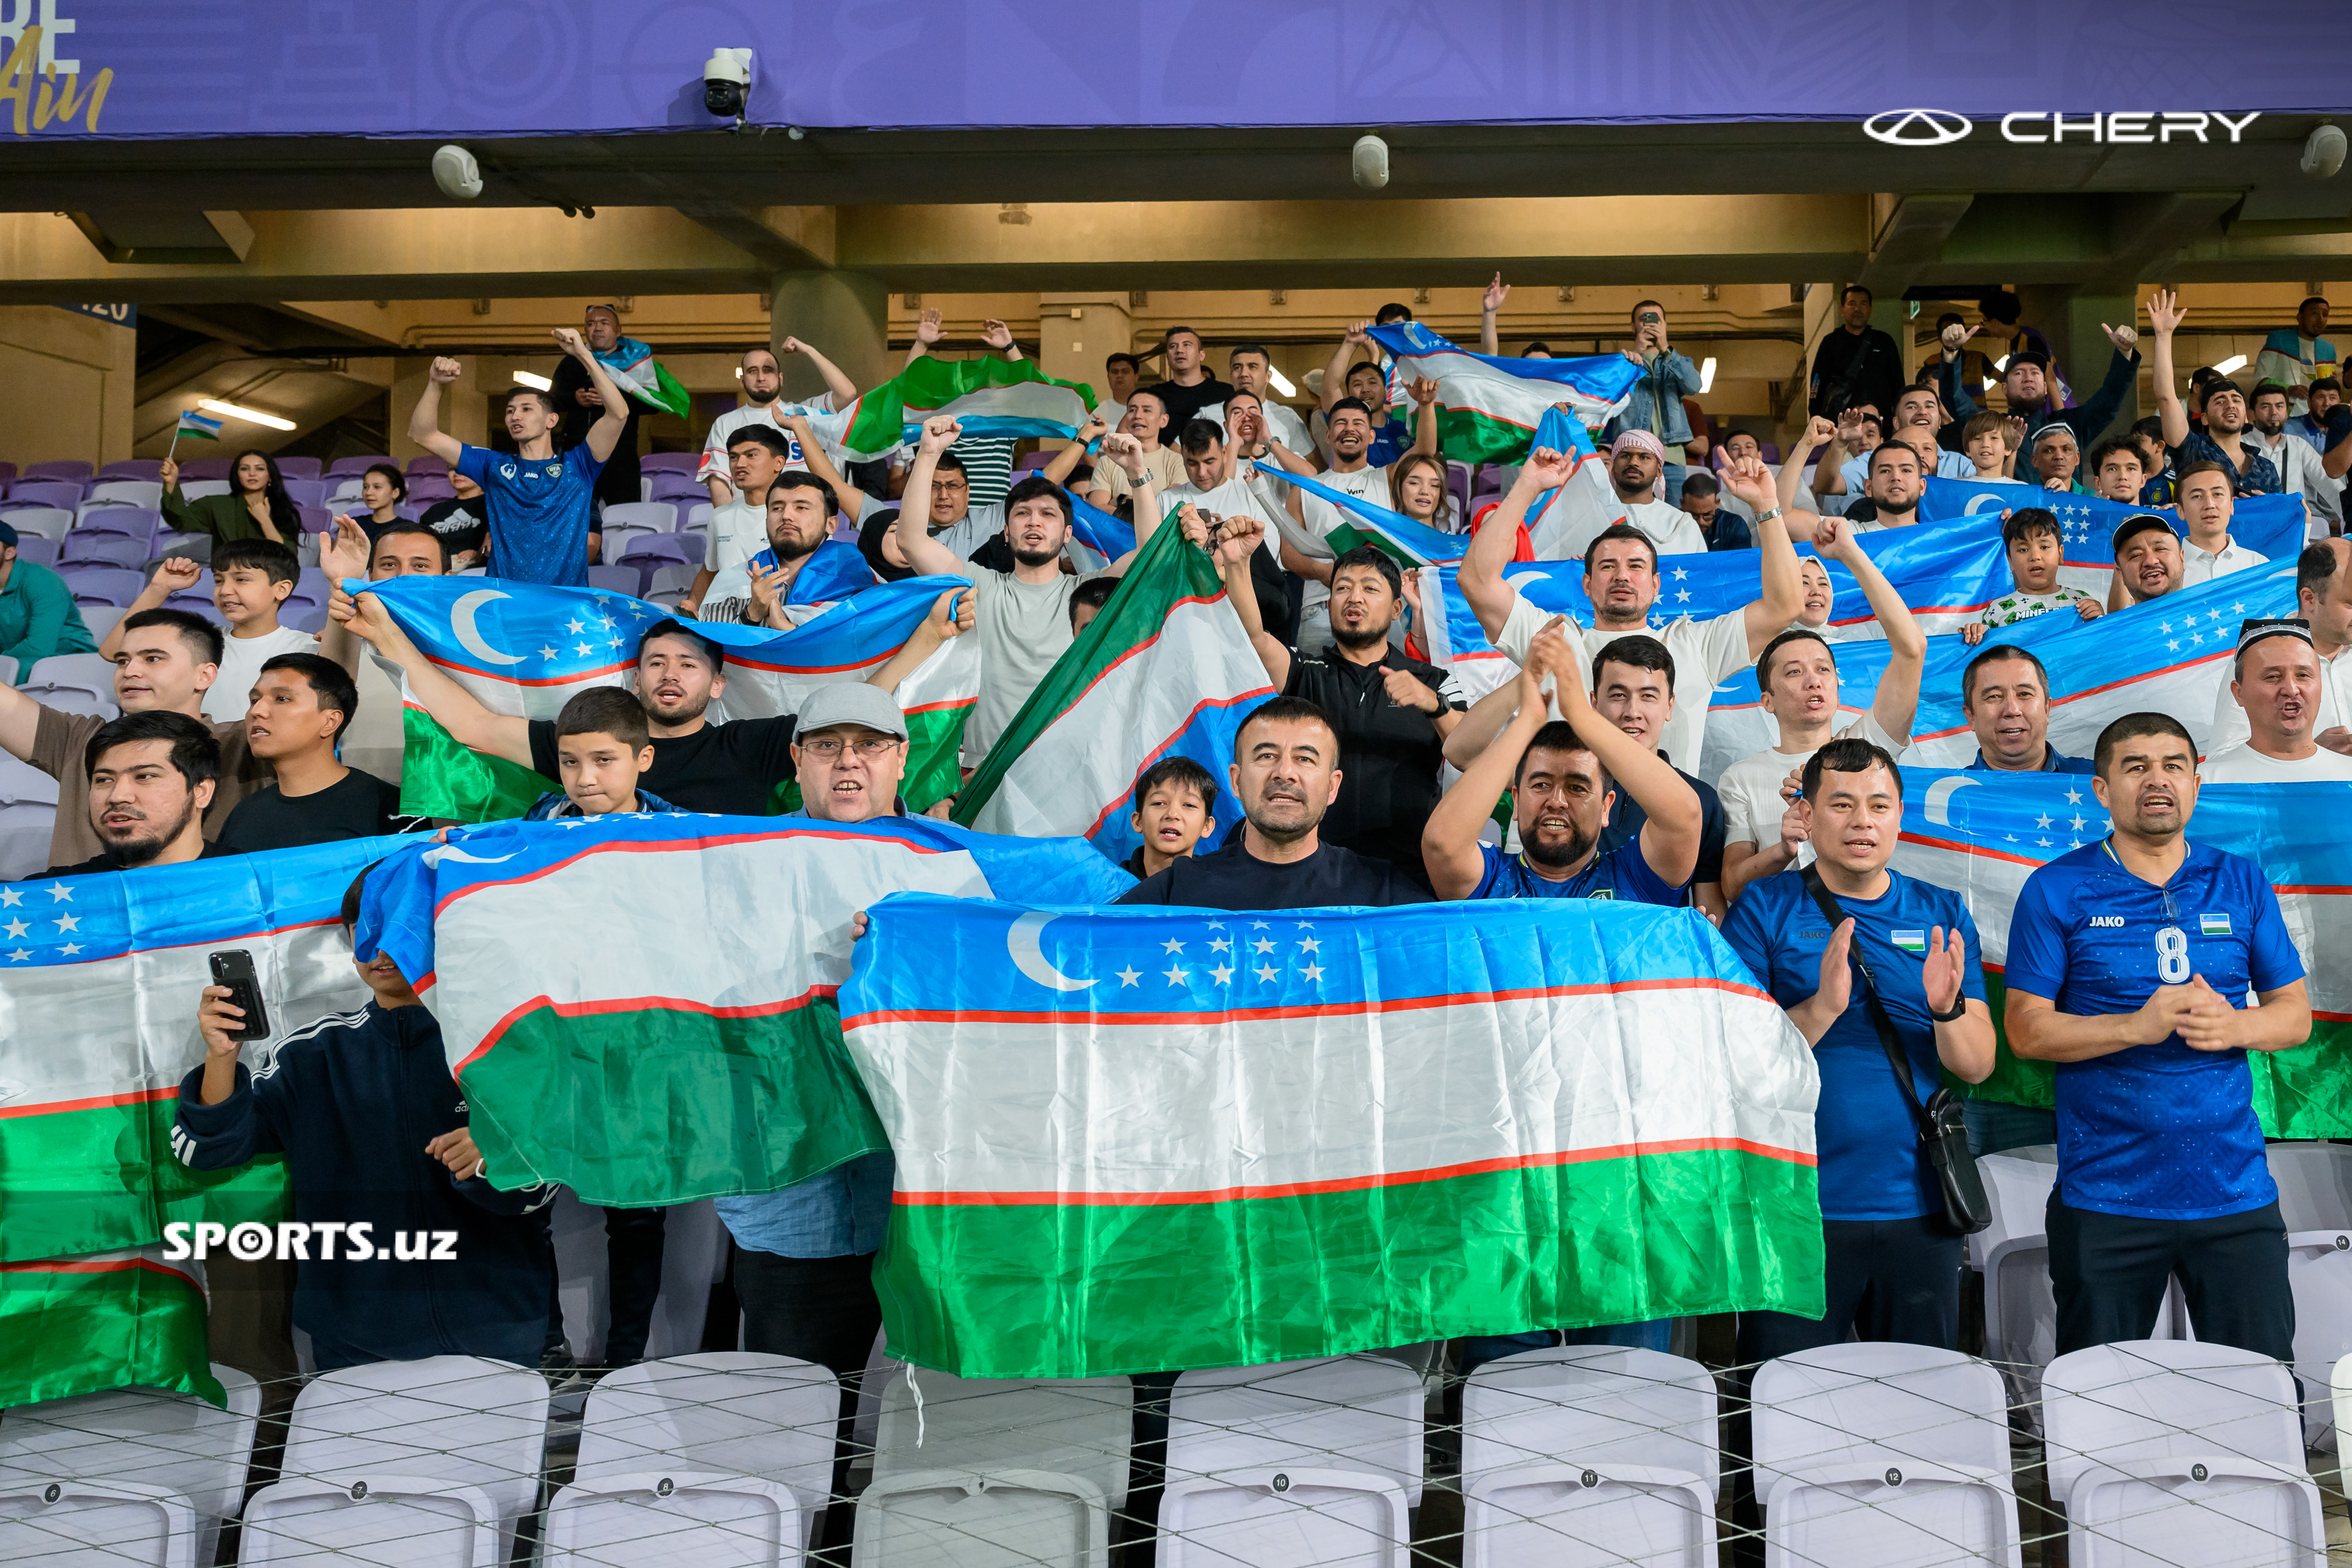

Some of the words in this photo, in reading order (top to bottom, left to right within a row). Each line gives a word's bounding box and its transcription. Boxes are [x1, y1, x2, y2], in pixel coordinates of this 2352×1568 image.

[2090, 916, 2124, 927] JAKO
[1799, 931, 1826, 939] JAKO
[2155, 927, 2190, 984] 8
[455, 1104, 470, 1112] adi
[1277, 1478, 1286, 1486] 10
